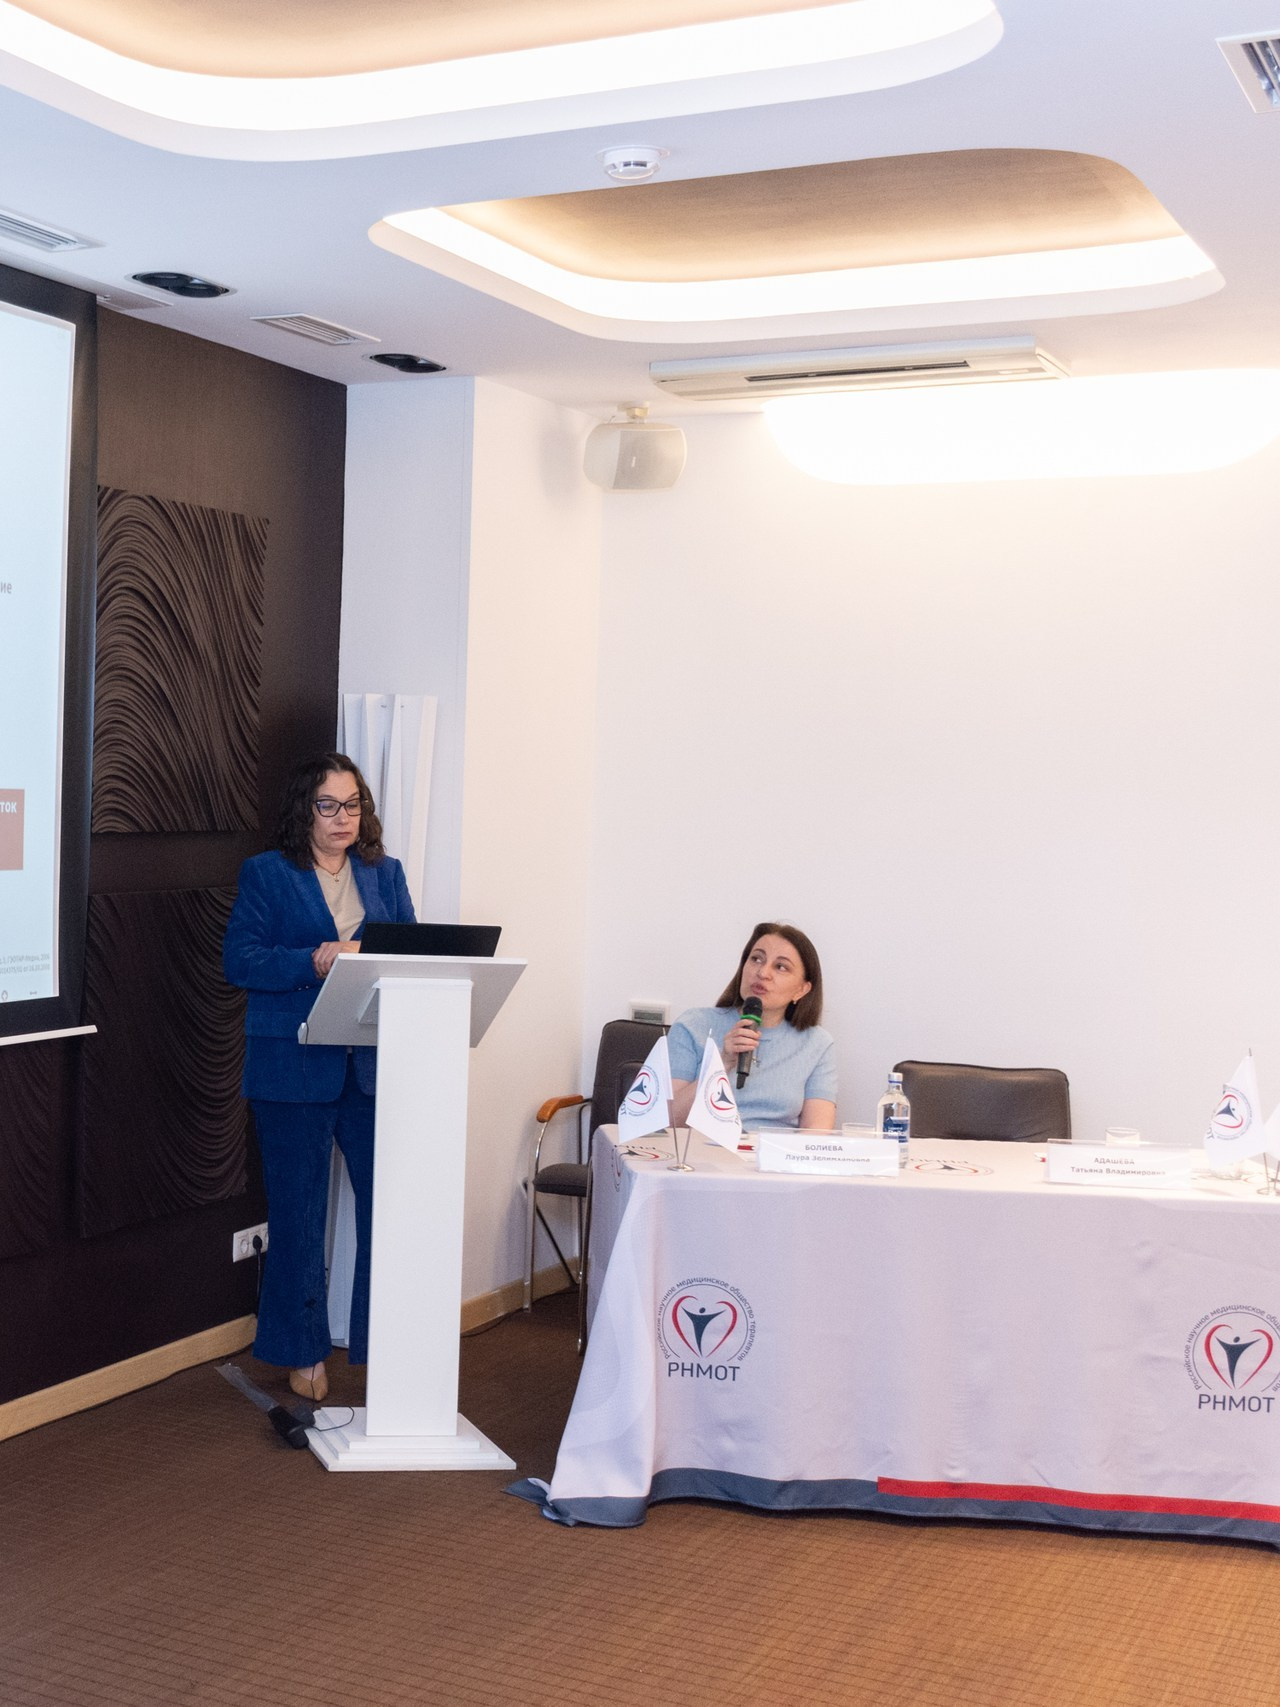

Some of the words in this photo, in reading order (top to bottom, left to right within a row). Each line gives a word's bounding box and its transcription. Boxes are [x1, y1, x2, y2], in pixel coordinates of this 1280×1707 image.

[785, 1154, 810, 1162] Лаура
[804, 1144, 844, 1152] БОЛИЕВА
[1070, 1166, 1104, 1174] Татьяна
[675, 1276, 730, 1289] медицинское
[729, 1286, 755, 1319] общество
[1210, 1304, 1266, 1317] медицинское
[1187, 1314, 1210, 1344] научное
[667, 1361, 741, 1382] РНМОТ
[1183, 1345, 1202, 1391] Российское
[1197, 1393, 1276, 1414] РНМОТ
